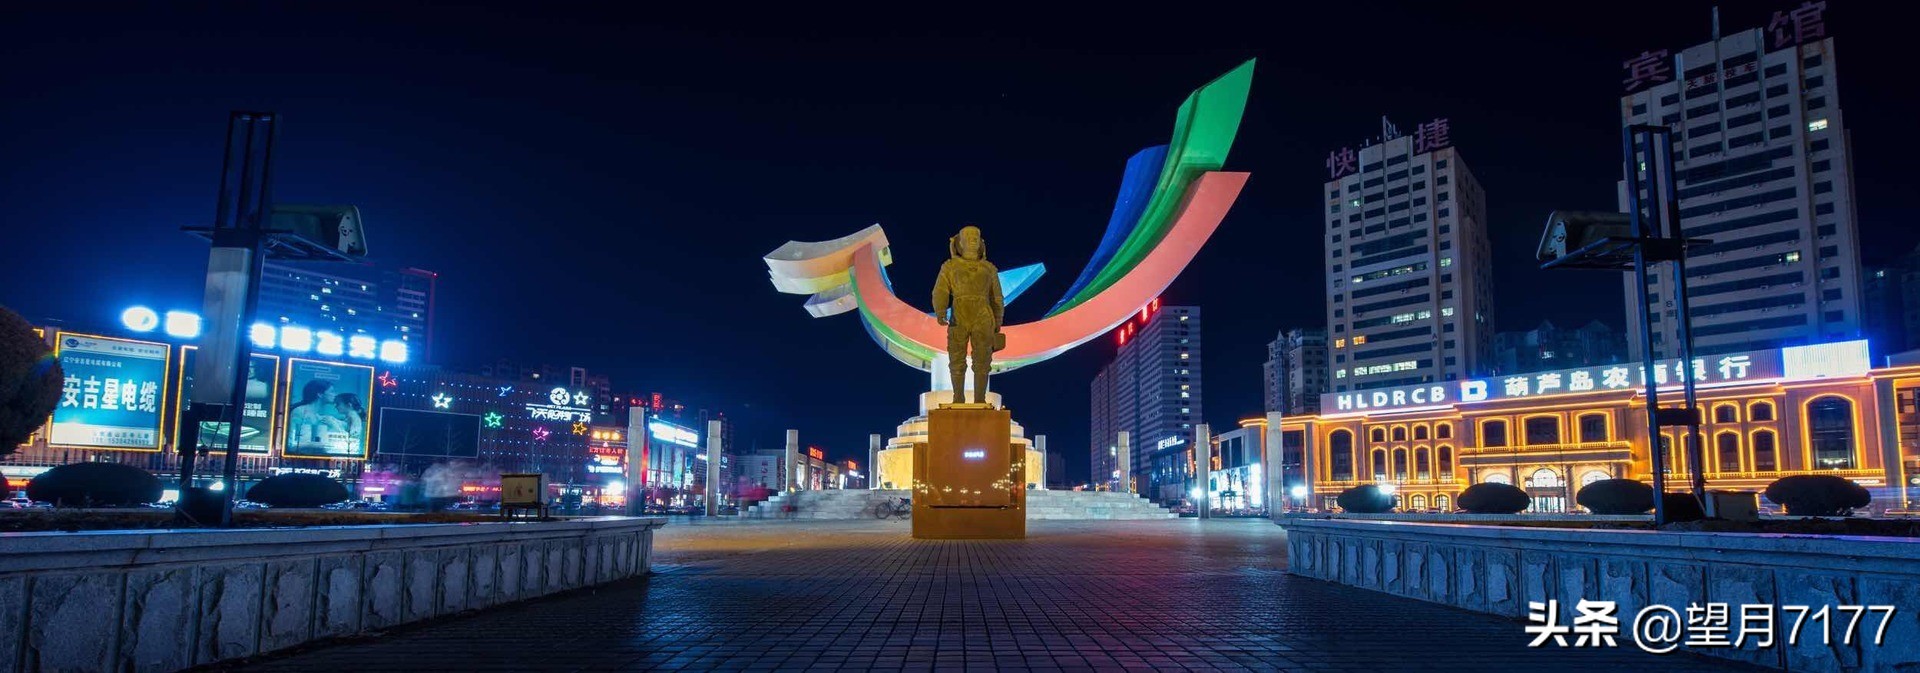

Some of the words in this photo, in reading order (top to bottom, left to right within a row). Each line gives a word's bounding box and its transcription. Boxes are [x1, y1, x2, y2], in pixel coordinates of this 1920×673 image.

[62, 374, 158, 413] 安吉星电缆
[1338, 386, 1446, 411] HLDRCB
